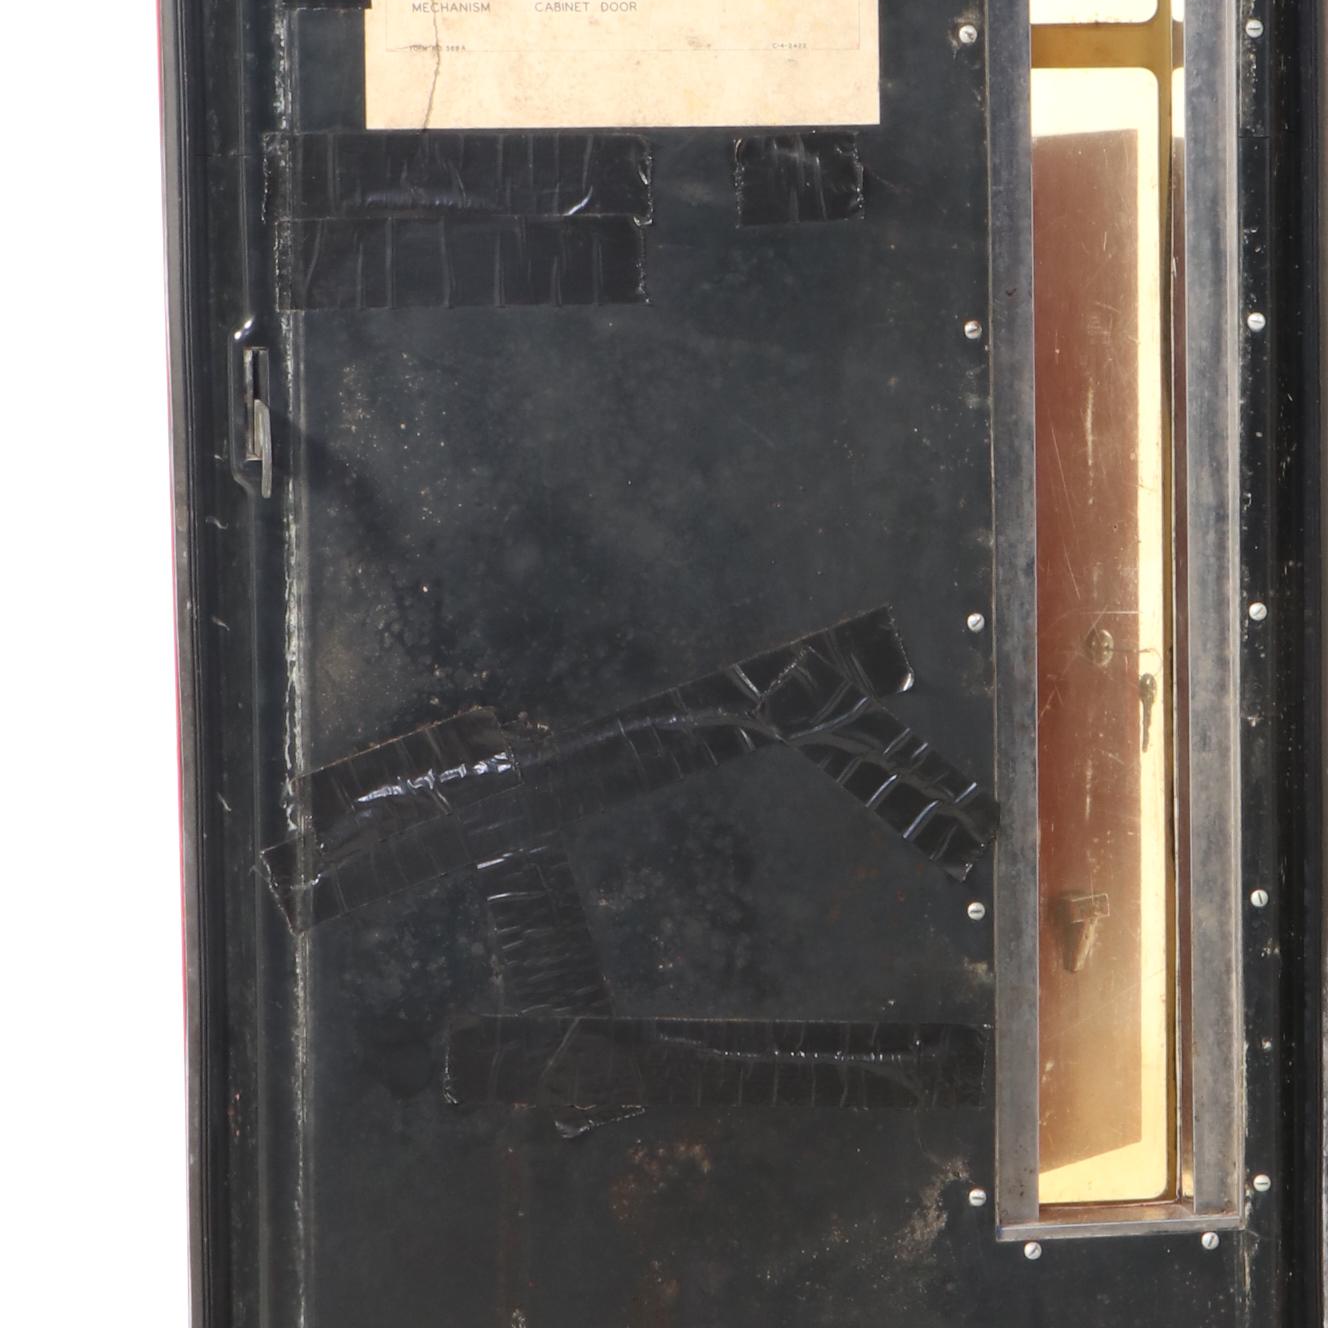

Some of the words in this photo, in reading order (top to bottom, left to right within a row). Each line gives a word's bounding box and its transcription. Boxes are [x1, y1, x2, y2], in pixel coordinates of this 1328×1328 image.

[411, 2, 491, 13] MECHANISM
[534, 2, 590, 13] CABINET
[600, 2, 638, 13] DOOR
